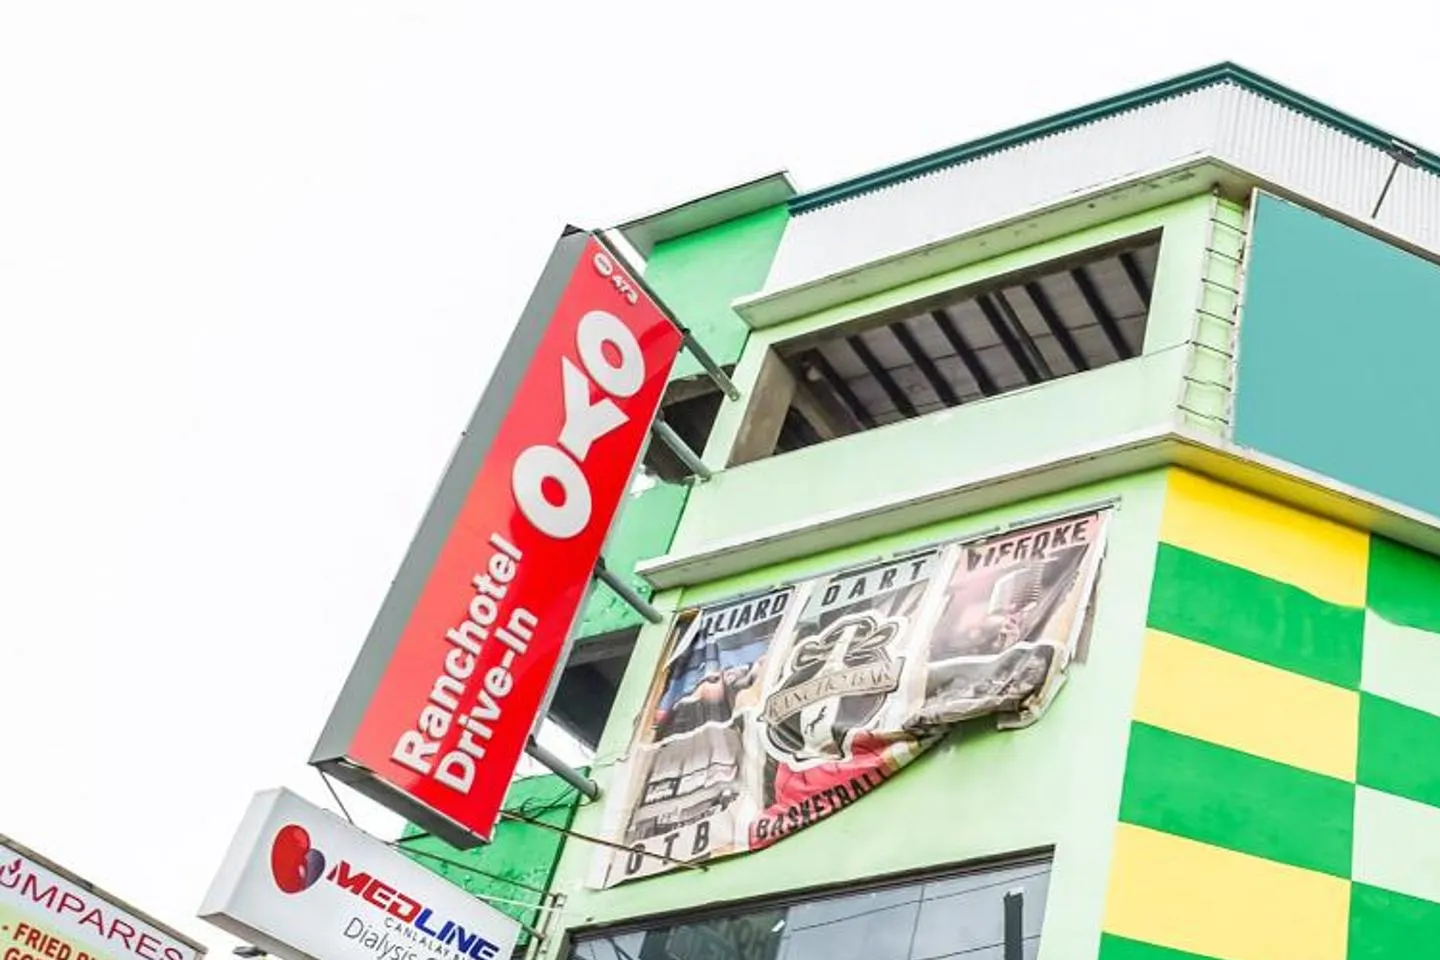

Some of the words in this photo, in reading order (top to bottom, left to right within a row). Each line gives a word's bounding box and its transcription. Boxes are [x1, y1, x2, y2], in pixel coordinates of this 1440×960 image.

[512, 310, 646, 539] OYO
[390, 532, 523, 775] Ranchotel
[821, 560, 926, 606] DART
[433, 607, 539, 795] Drive-In
[625, 820, 711, 876] OTB
